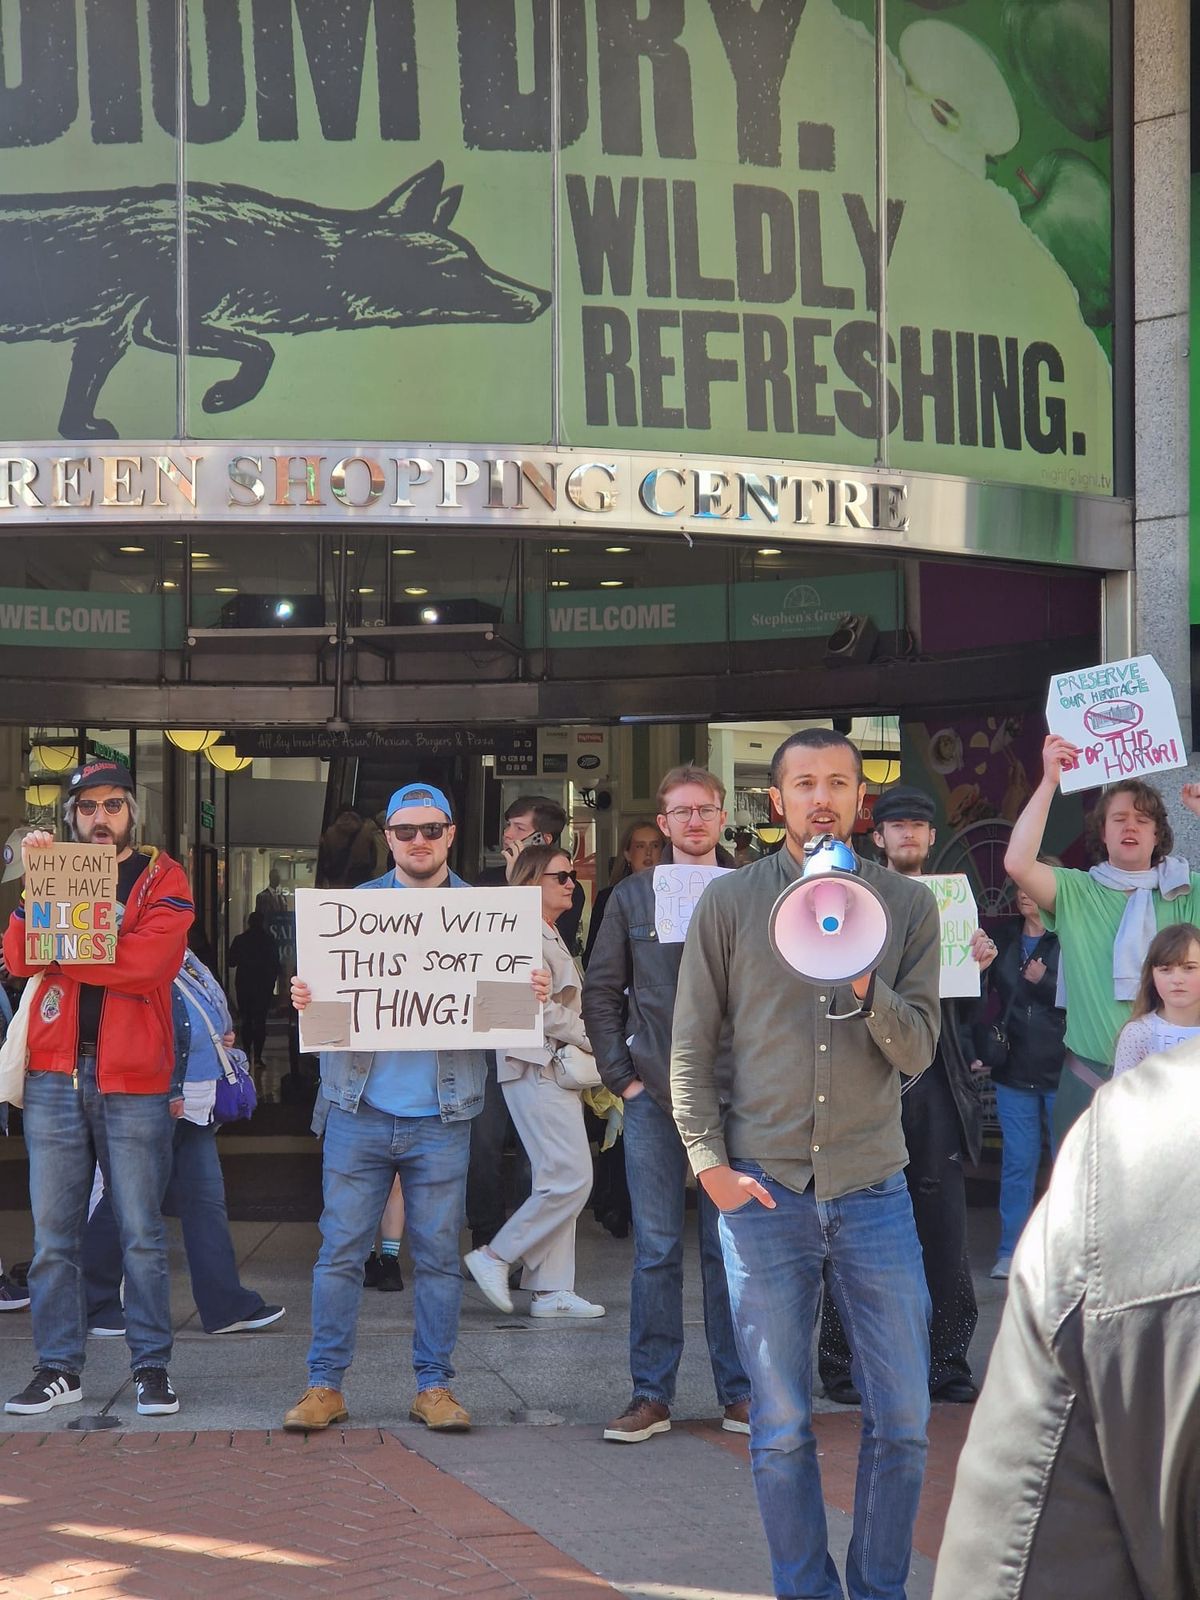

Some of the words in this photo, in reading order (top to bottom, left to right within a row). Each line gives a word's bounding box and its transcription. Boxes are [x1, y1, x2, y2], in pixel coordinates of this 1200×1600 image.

[566, 174, 906, 312] WILDLY
[581, 306, 1086, 456] REFRESHING.
[227, 455, 618, 512] SHOPPING
[638, 468, 910, 531] CENTRE
[0, 604, 130, 633] WELCOME
[549, 603, 676, 632] WELCOME
[751, 609, 813, 628] Stephen's
[1056, 663, 1141, 696] PRESERVE
[1060, 692, 1086, 709] OUR
[416, 732, 453, 753] Burgers
[454, 731, 463, 748] &
[465, 730, 495, 747] Pizza
[1105, 729, 1153, 757] THIS
[1103, 739, 1179, 779] HORROR!
[28, 855, 67, 873] WHY
[72, 853, 115, 874] CAN'T
[30, 878, 56, 897] WE
[68, 878, 111, 898] HAVE
[664, 867, 714, 895] SA
[32, 901, 112, 930] NICE
[319, 902, 424, 937] DOWN
[441, 906, 518, 934] WITH
[27, 933, 116, 962] THINGS?
[328, 950, 407, 980] THIS
[423, 950, 484, 973] SORT
[495, 954, 534, 974] OF
[336, 988, 471, 1033] THING!
